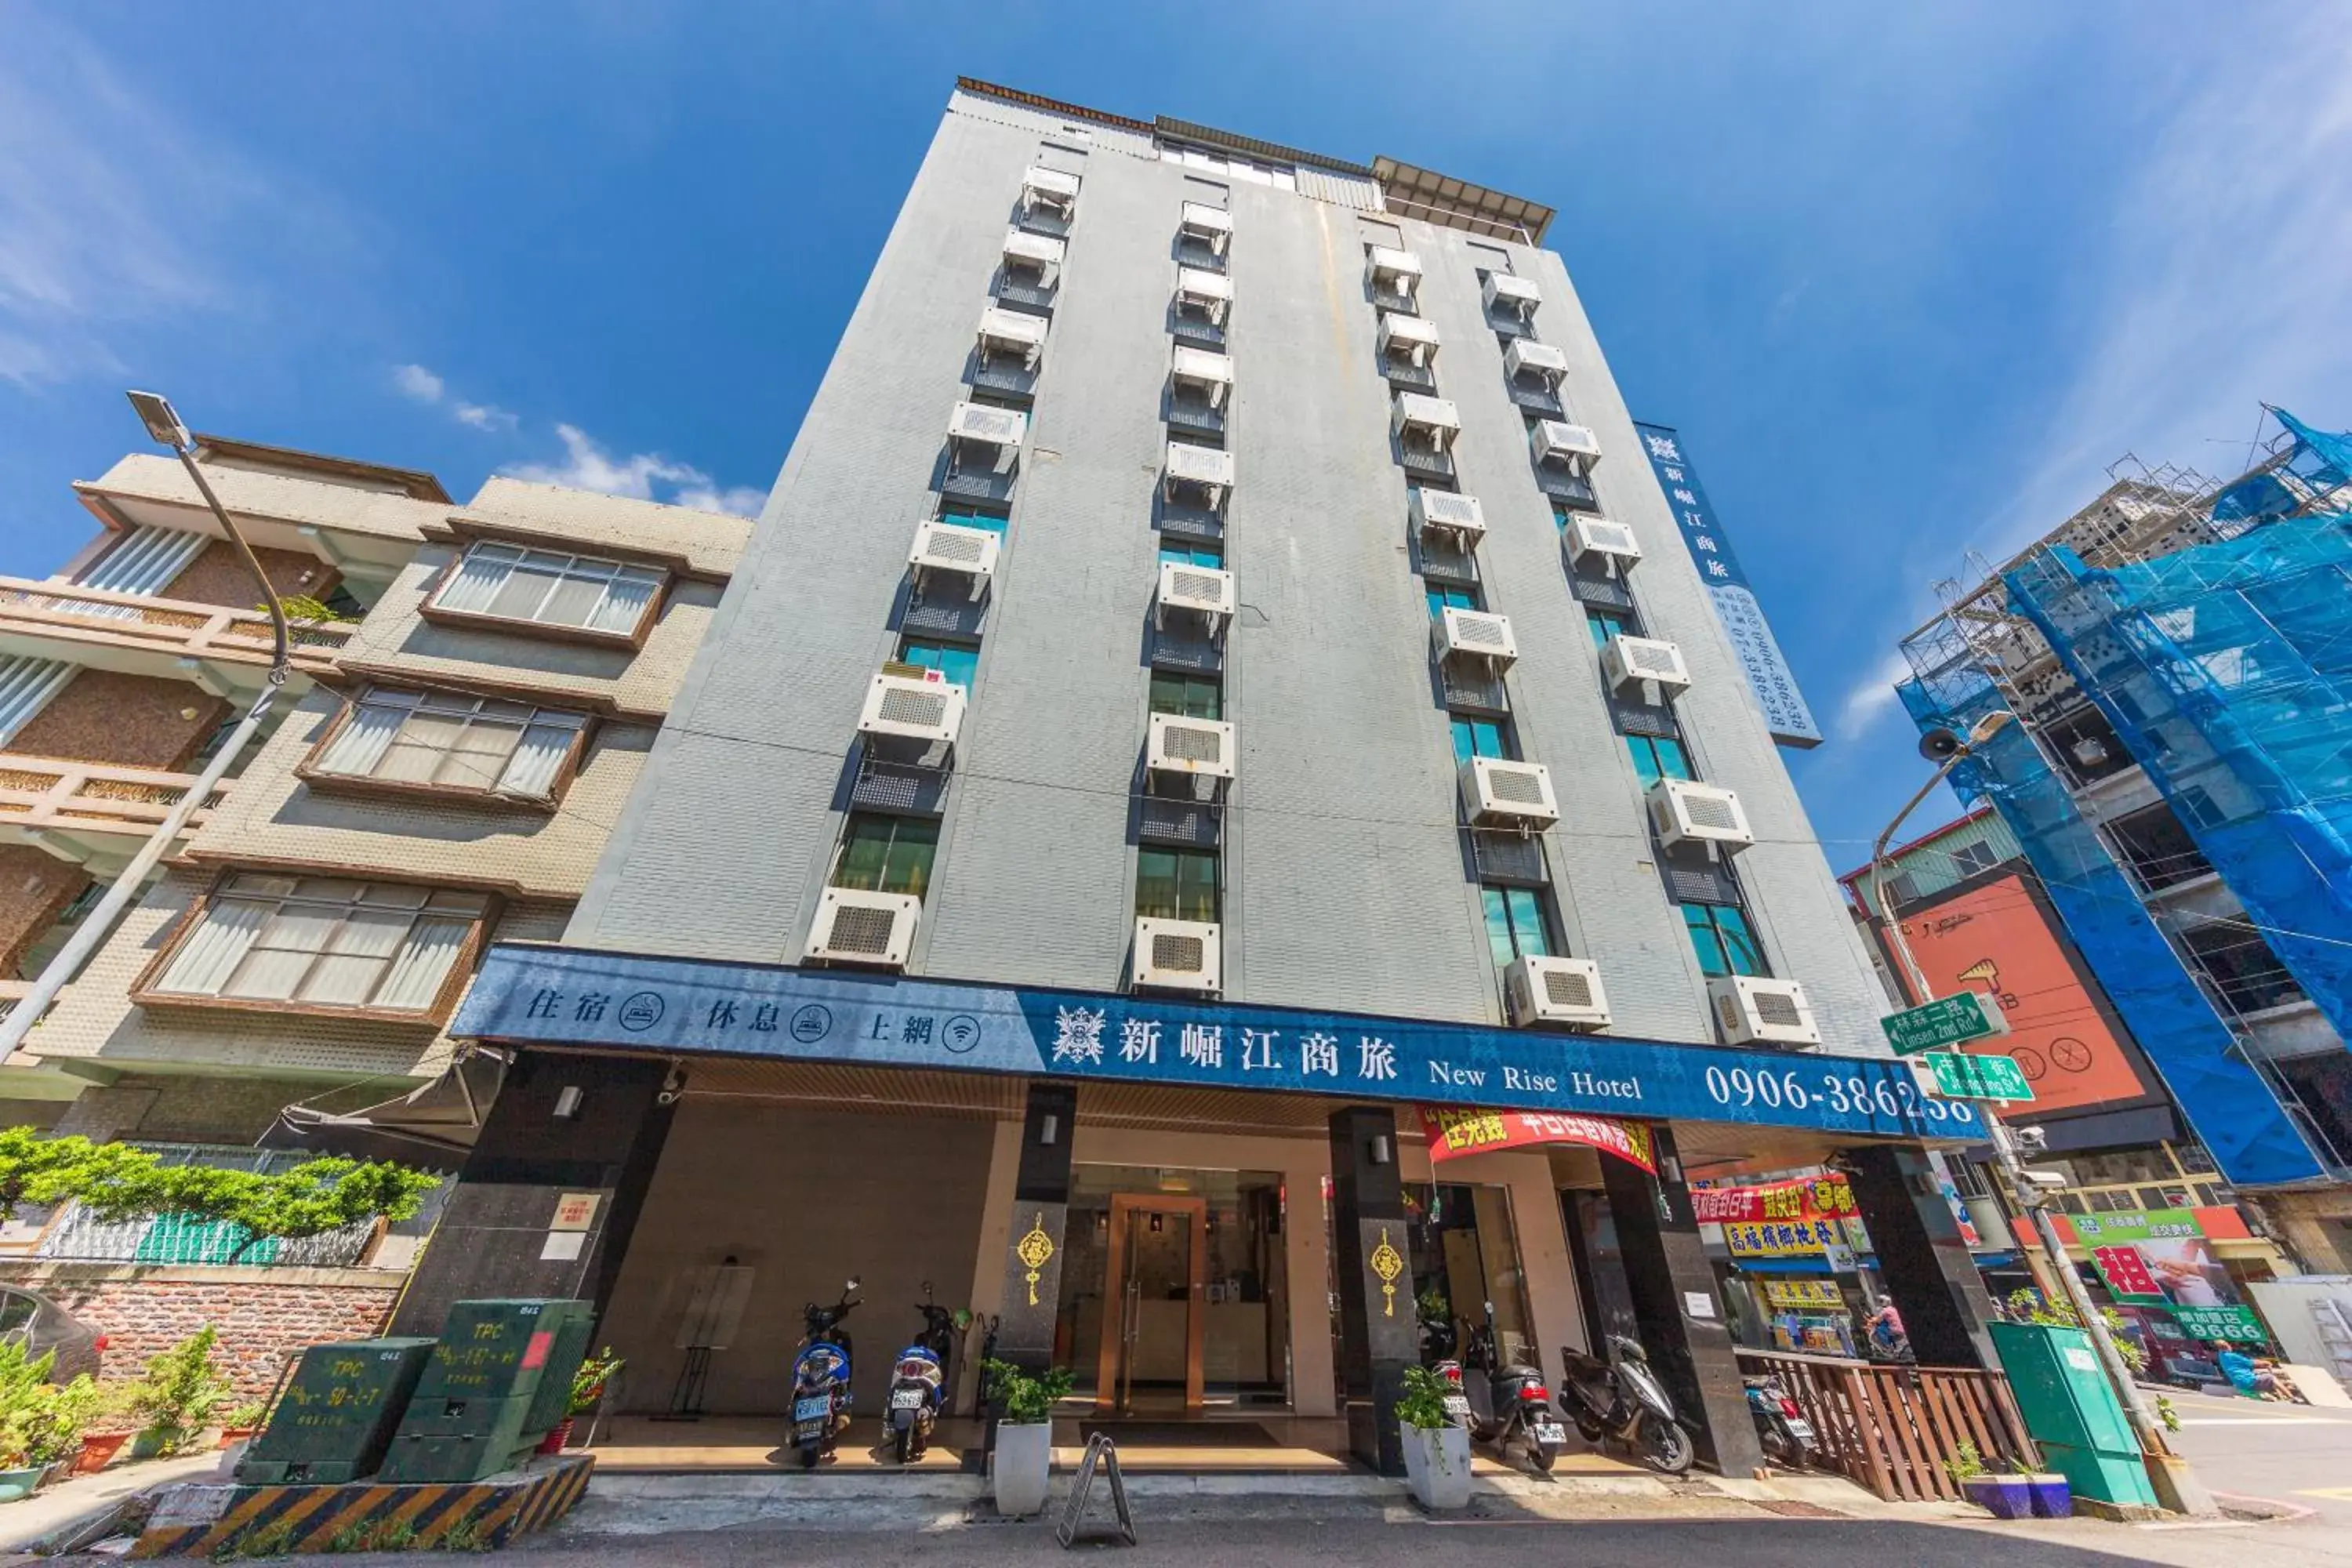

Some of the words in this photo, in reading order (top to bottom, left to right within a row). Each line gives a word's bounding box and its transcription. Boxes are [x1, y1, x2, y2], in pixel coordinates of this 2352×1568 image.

[526, 988, 609, 1022] 住宿
[706, 999, 779, 1033] 休息
[1894, 1000, 1965, 1033] 林森二路
[862, 1015, 931, 1044] 上網
[1900, 1029, 1936, 1049] Linsen
[1935, 1022, 1958, 1038] 2nd
[1956, 1015, 1980, 1034] Rd.
[1118, 1018, 1398, 1080] 新崛江商旅
[1429, 1060, 1486, 1087] New
[1504, 1065, 1557, 1093] Rise
[1571, 1071, 1642, 1100] Hotel
